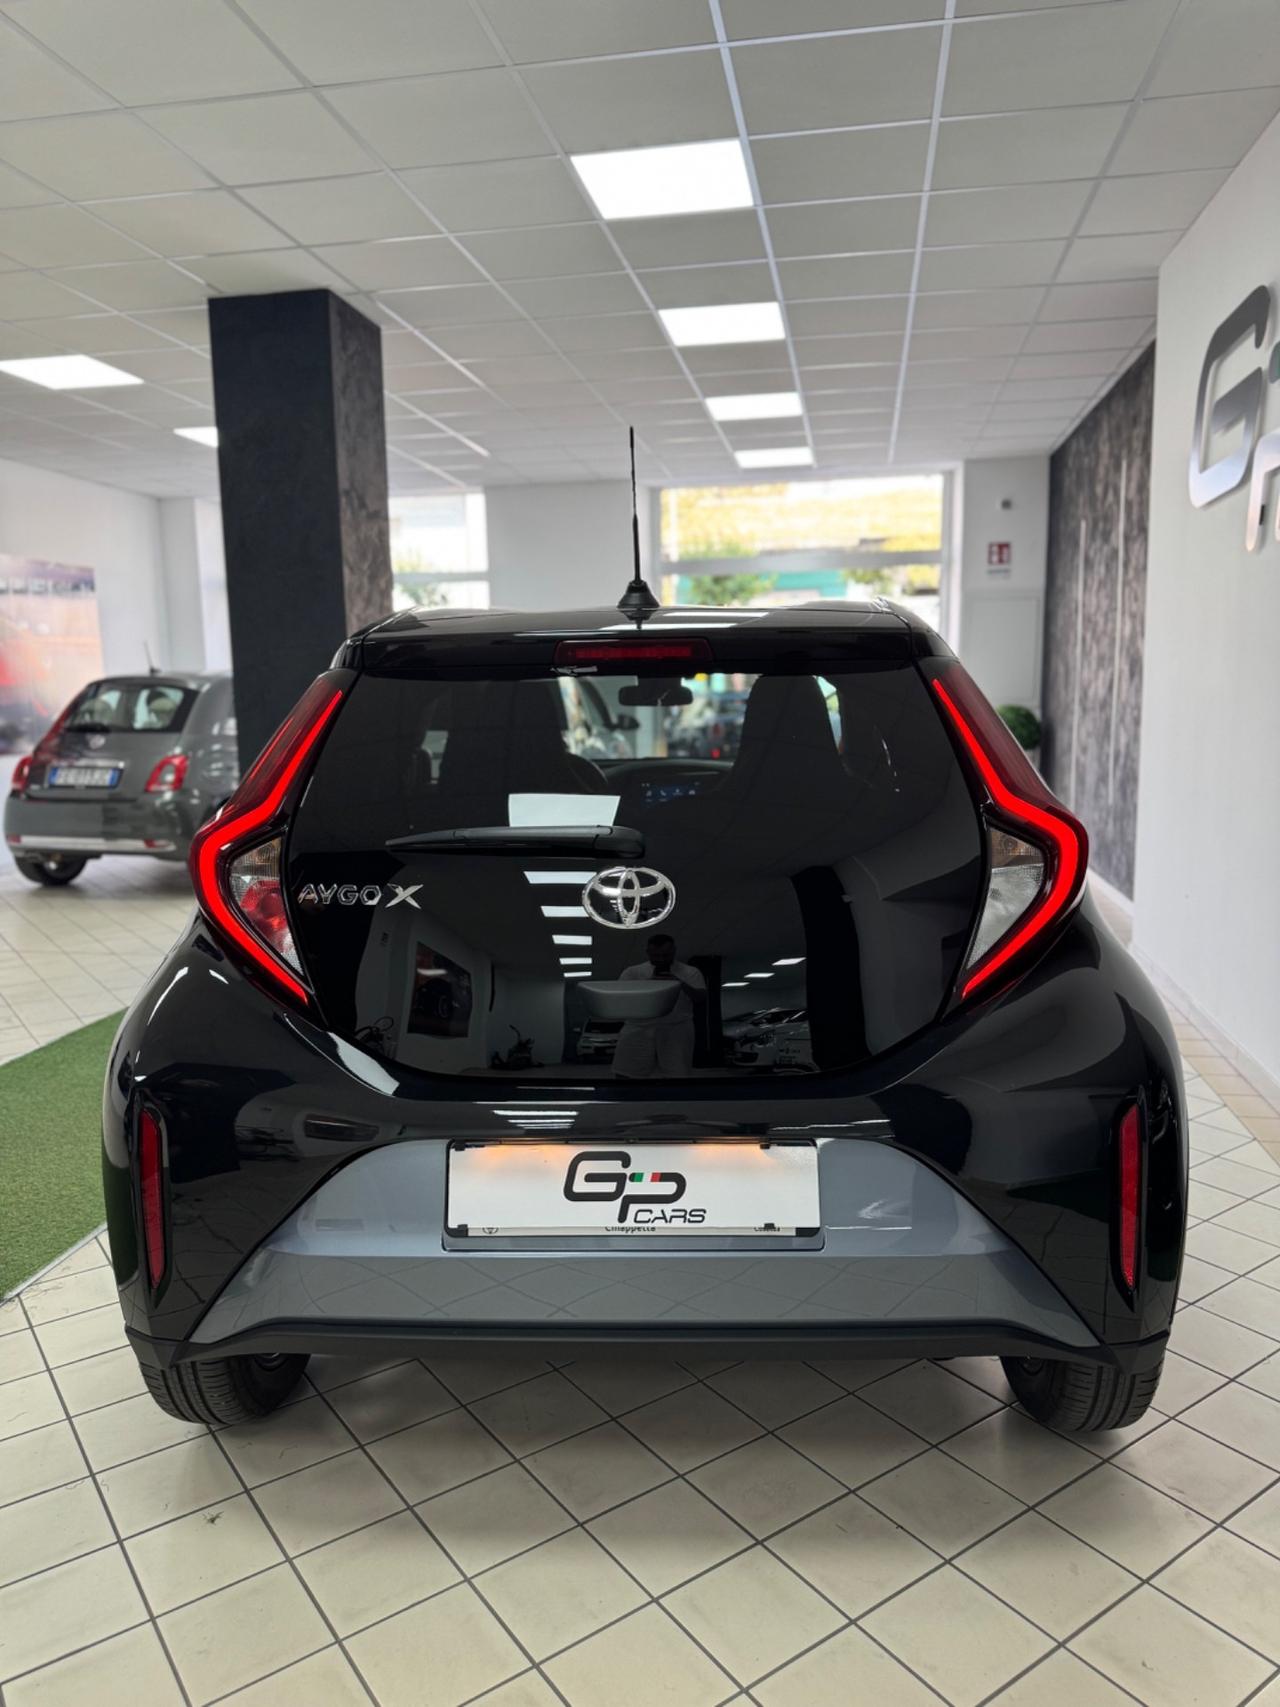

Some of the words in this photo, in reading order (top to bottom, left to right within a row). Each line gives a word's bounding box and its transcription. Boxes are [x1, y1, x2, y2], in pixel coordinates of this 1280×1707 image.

[298, 883, 383, 906] AYGO
[385, 883, 424, 909] X
[633, 1208, 707, 1225] CARS
